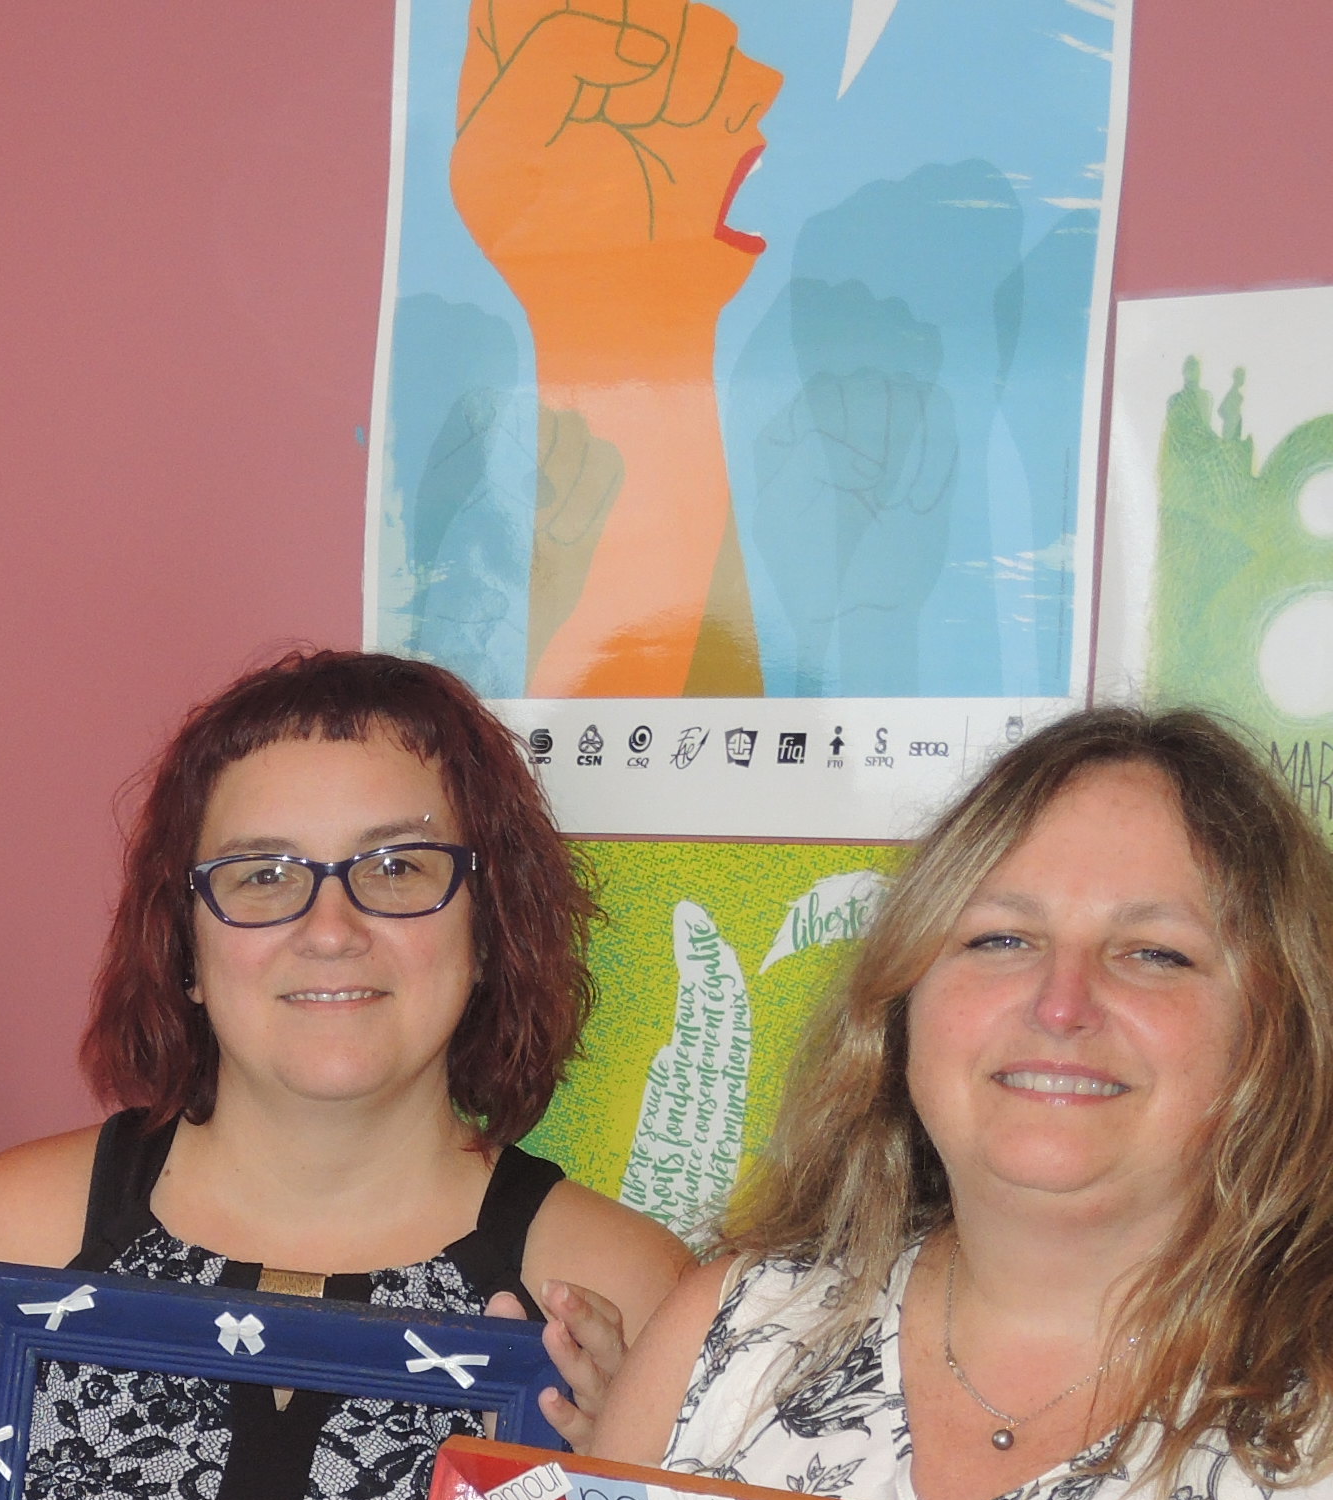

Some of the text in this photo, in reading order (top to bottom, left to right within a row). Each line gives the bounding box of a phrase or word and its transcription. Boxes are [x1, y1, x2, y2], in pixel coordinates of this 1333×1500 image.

[577, 755, 602, 766] CSN
[627, 757, 649, 769] CSQ
[827, 759, 843, 769] FTQ
[865, 756, 894, 768] SFPQ
[685, 919, 736, 1002] égalité
[730, 988, 753, 1034] paix
[655, 981, 701, 1148] fondamentaux
[694, 1003, 725, 1144] consentement
[619, 1058, 672, 1206] liberté sexuelle
